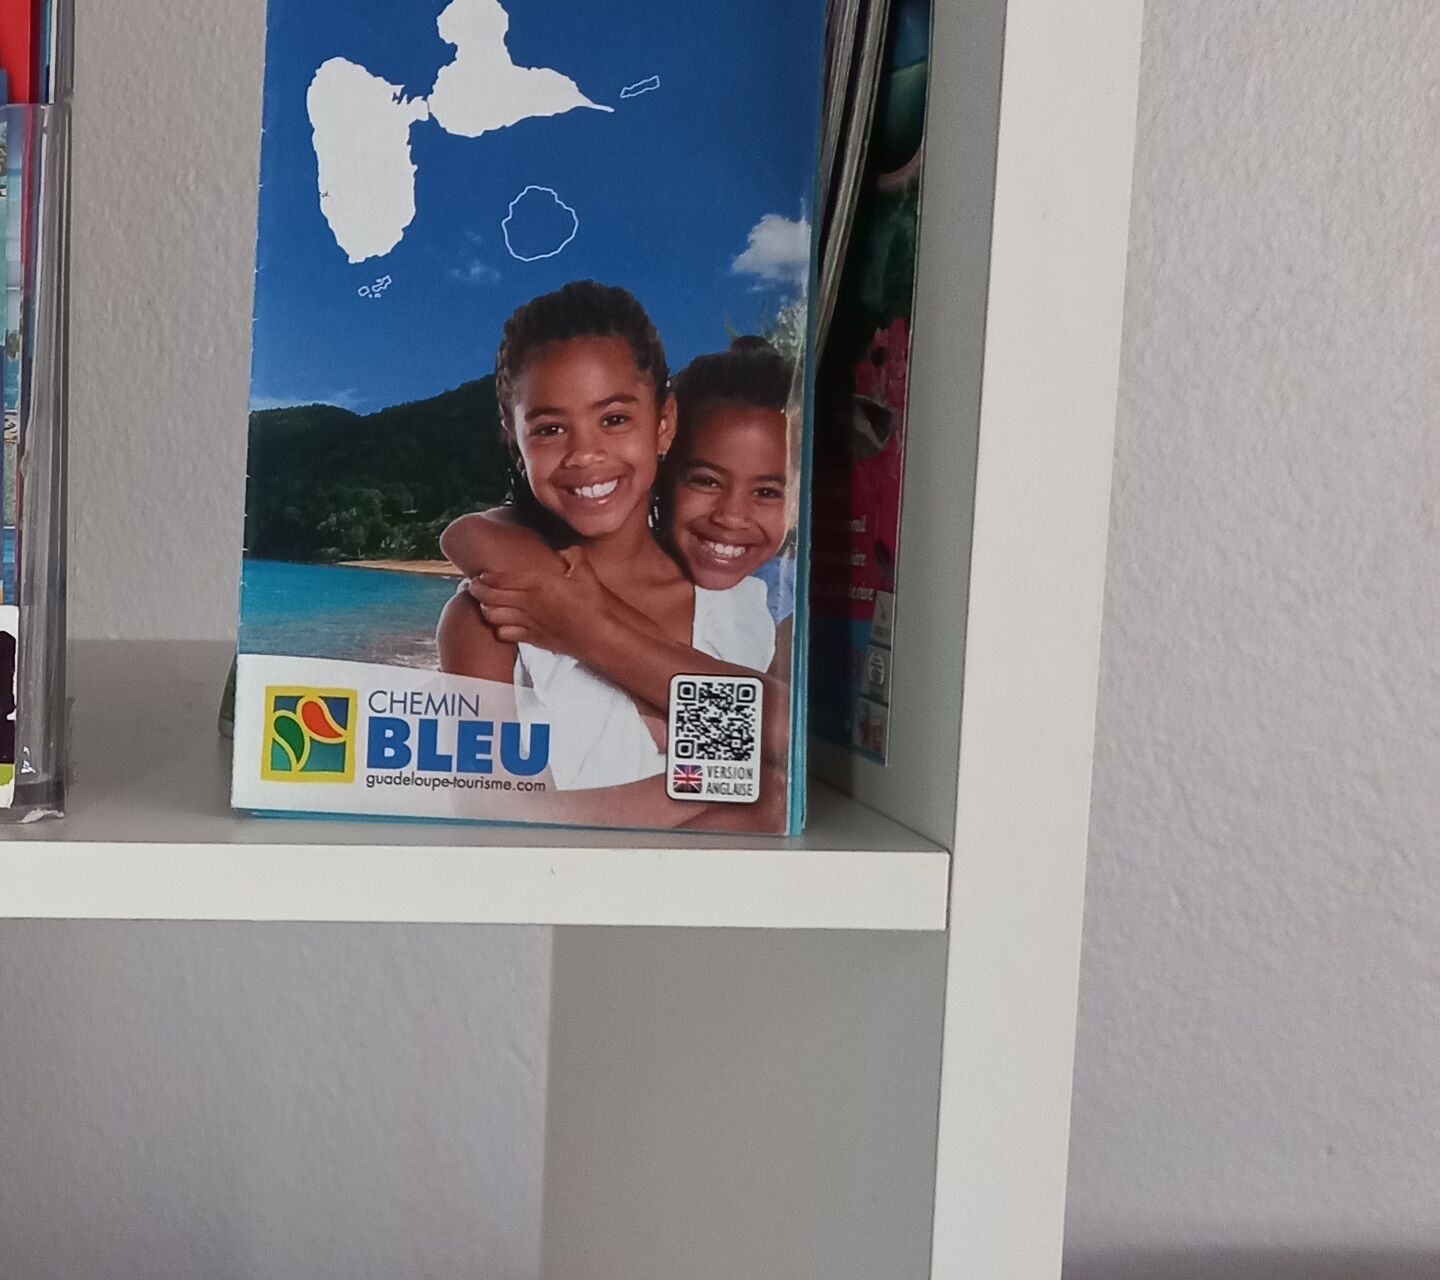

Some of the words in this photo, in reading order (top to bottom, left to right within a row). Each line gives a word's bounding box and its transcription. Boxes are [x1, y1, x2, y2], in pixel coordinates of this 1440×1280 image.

[368, 690, 481, 718] CHEMIN
[366, 716, 551, 777] BLEU
[366, 770, 546, 794] guadeloupe-tourisme.com
[706, 766, 754, 782] VERSION
[705, 782, 754, 798] ANGLAISE
